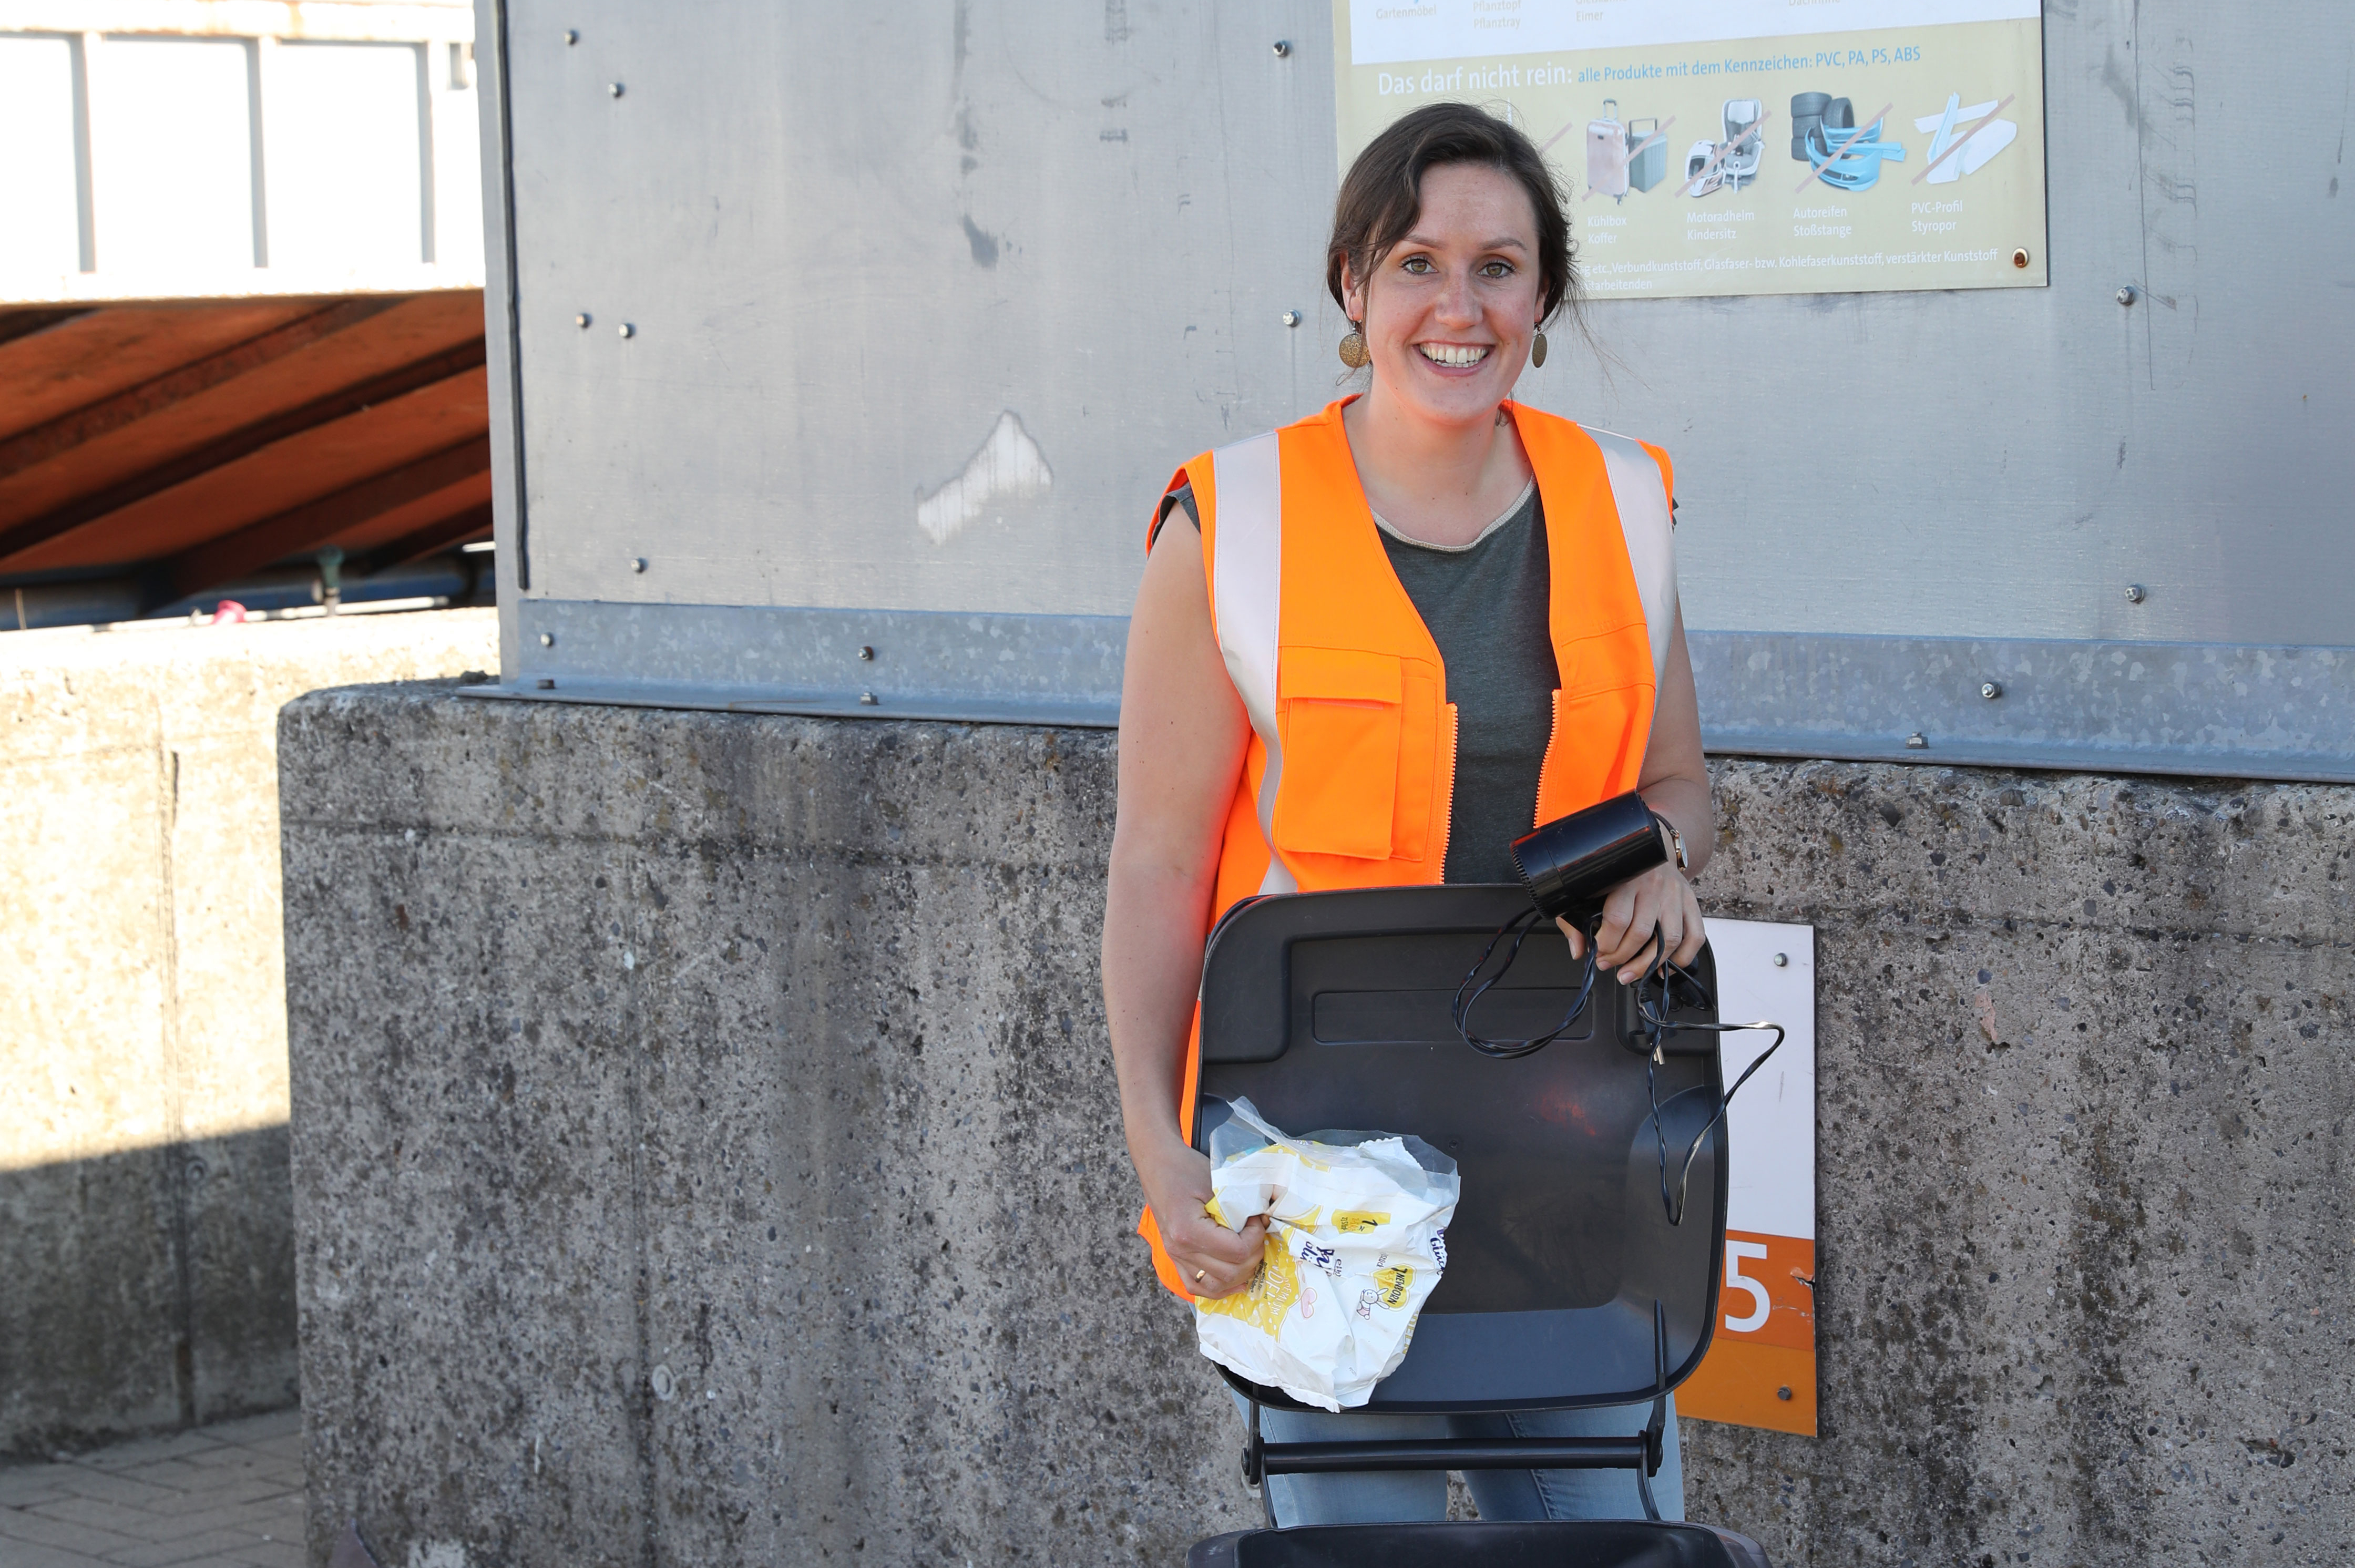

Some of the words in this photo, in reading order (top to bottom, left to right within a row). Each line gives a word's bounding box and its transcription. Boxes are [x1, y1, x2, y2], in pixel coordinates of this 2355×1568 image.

[1376, 5, 1436, 19] Gartenmöbel
[1473, 0, 1521, 12] Pflanztopf
[1576, 11, 1603, 22] Eimer
[1474, 17, 1520, 29] Pflanztray
[1579, 68, 1600, 82] alle
[1605, 64, 1662, 80] Produkte
[1666, 62, 1687, 76] mit
[1692, 60, 1720, 75] dem
[1725, 54, 1811, 72] Kennzeichen:
[1816, 52, 1845, 68] PVC,
[1849, 50, 1868, 66] PA,
[1872, 48, 1890, 65] PS,
[1895, 46, 1920, 62] ABS
[1379, 73, 1414, 95] Das
[1421, 66, 1463, 93] darf
[1469, 64, 1520, 89] nicht
[1527, 62, 1572, 85] rein:
[1794, 206, 1847, 218] Autoreifen
[1912, 200, 1962, 213] PVC-Profil
[1588, 216, 1626, 227] Kühlbox
[1687, 210, 1754, 222] Motoradhelm
[1687, 228, 1736, 240] Kindersitz
[1794, 224, 1851, 238] Stoßstange
[1912, 221, 1956, 235] Styropor
[1589, 232, 1617, 244] Koffer
[1704, 258, 1752, 270] Glasfaser-
[1755, 257, 1777, 268] bzw.
[1779, 253, 1884, 267] Kohlefaserkunststoff,
[1886, 251, 1941, 263] verstärkter
[1944, 249, 1998, 261] Kunststoff
[1584, 278, 1652, 290] itarbeitenden
[1387, 1273, 1405, 1305] NEWBORN
[1725, 1241, 1770, 1333] 5
